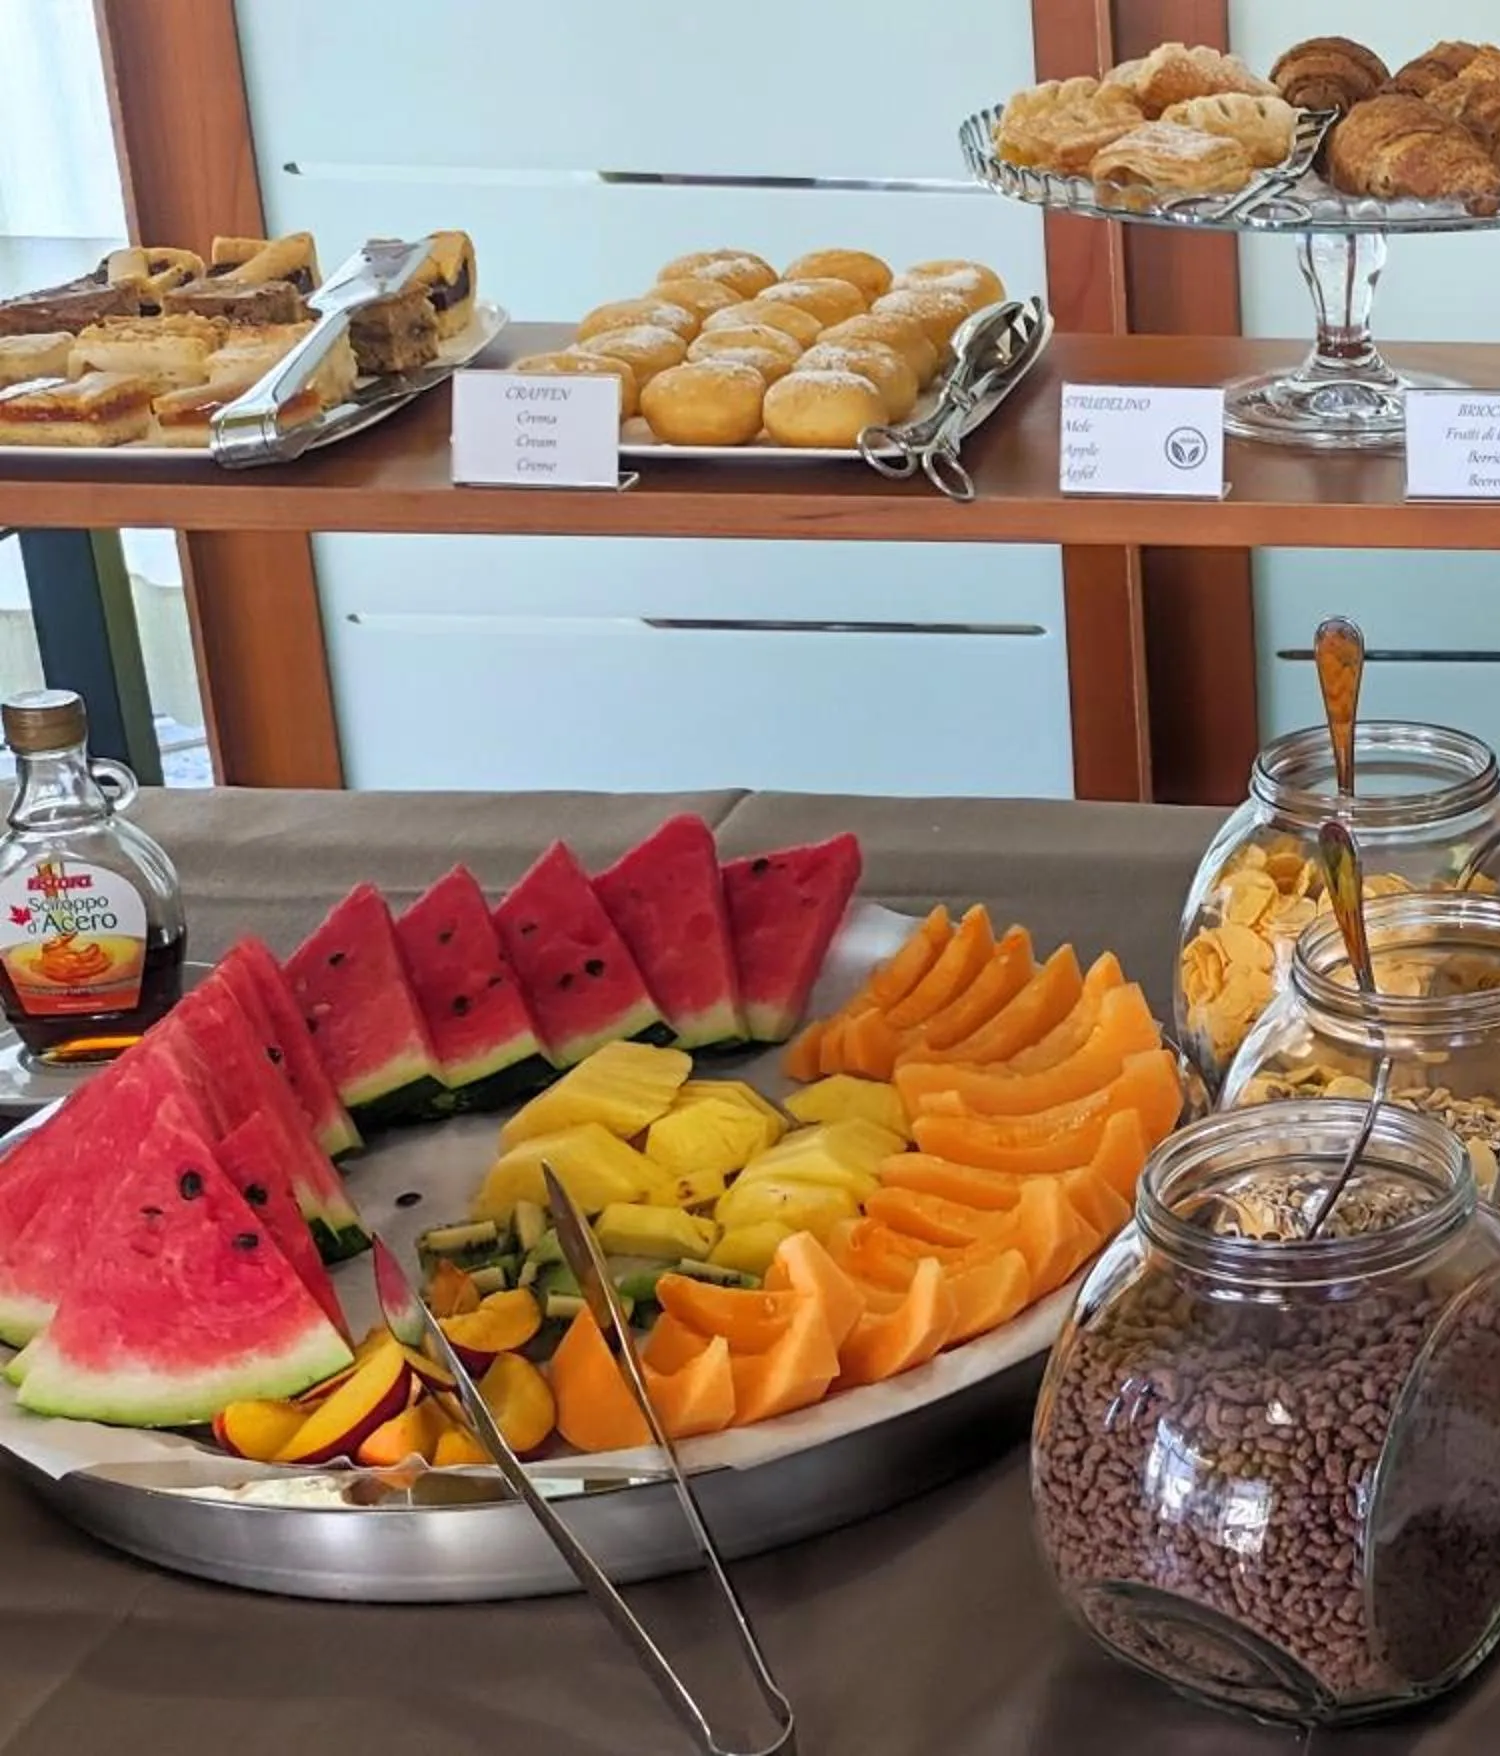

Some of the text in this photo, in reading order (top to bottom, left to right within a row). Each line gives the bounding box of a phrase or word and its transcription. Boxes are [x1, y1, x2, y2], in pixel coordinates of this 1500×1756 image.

[1064, 395, 1151, 412] STRUDELINO
[516, 410, 558, 426] Crema
[515, 433, 558, 448] Cream
[1445, 426, 1481, 441] Frutti
[1481, 426, 1496, 441] di
[28, 896, 109, 915] Sciroppo
